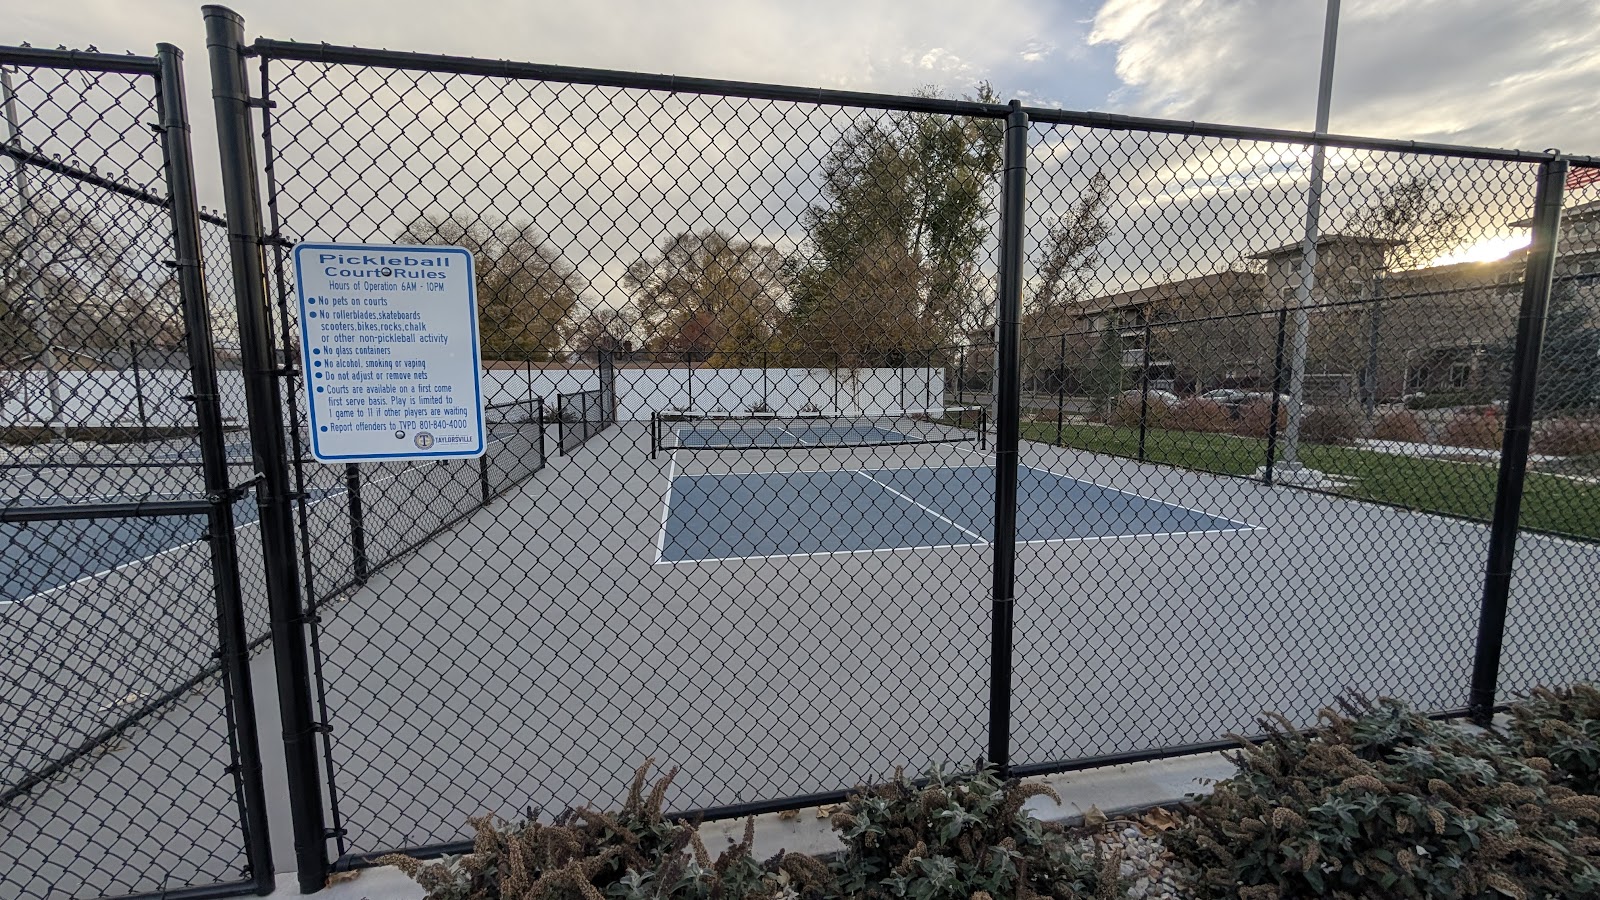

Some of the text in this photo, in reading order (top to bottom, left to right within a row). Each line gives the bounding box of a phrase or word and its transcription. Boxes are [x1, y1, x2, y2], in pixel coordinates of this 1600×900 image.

[320, 254, 449, 267] Pickleball
[325, 267, 446, 279] Court Rules
[330, 281, 350, 290] Hours
[354, 281, 360, 290] of
[364, 282, 398, 291] Operation
[401, 282, 416, 291] 6AM
[427, 282, 444, 291] 10PM
[318, 296, 329, 305] No
[333, 296, 348, 307] pets
[364, 298, 387, 306] courts
[320, 310, 330, 318] No
[334, 334, 355, 342] other
[360, 334, 415, 344] non-pickleball
[420, 334, 448, 345] activity
[323, 346, 390, 356] No glass containers
[324, 359, 334, 368] No
[365, 359, 392, 369] smoking
[404, 359, 426, 369] vaping
[325, 371, 335, 380] Do
[352, 371, 373, 382] adjust
[414, 371, 427, 380] nets
[327, 385, 349, 394] Courts
[366, 384, 397, 393] available
[418, 384, 431, 392] first
[328, 397, 342, 406] first
[369, 396, 388, 405] basis.
[391, 396, 407, 406] Play
[410, 396, 416, 404] is
[419, 396, 442, 404] limited
[329, 409, 332, 418] 1
[335, 410, 354, 420] game
[357, 409, 364, 417] to
[368, 408, 373, 417] 11
[376, 408, 381, 416] if
[384, 408, 401, 416] other
[404, 407, 427, 418] players
[444, 407, 467, 417] waiting
[330, 420, 467, 434] Report offenders to TVPD 801-840-4000
